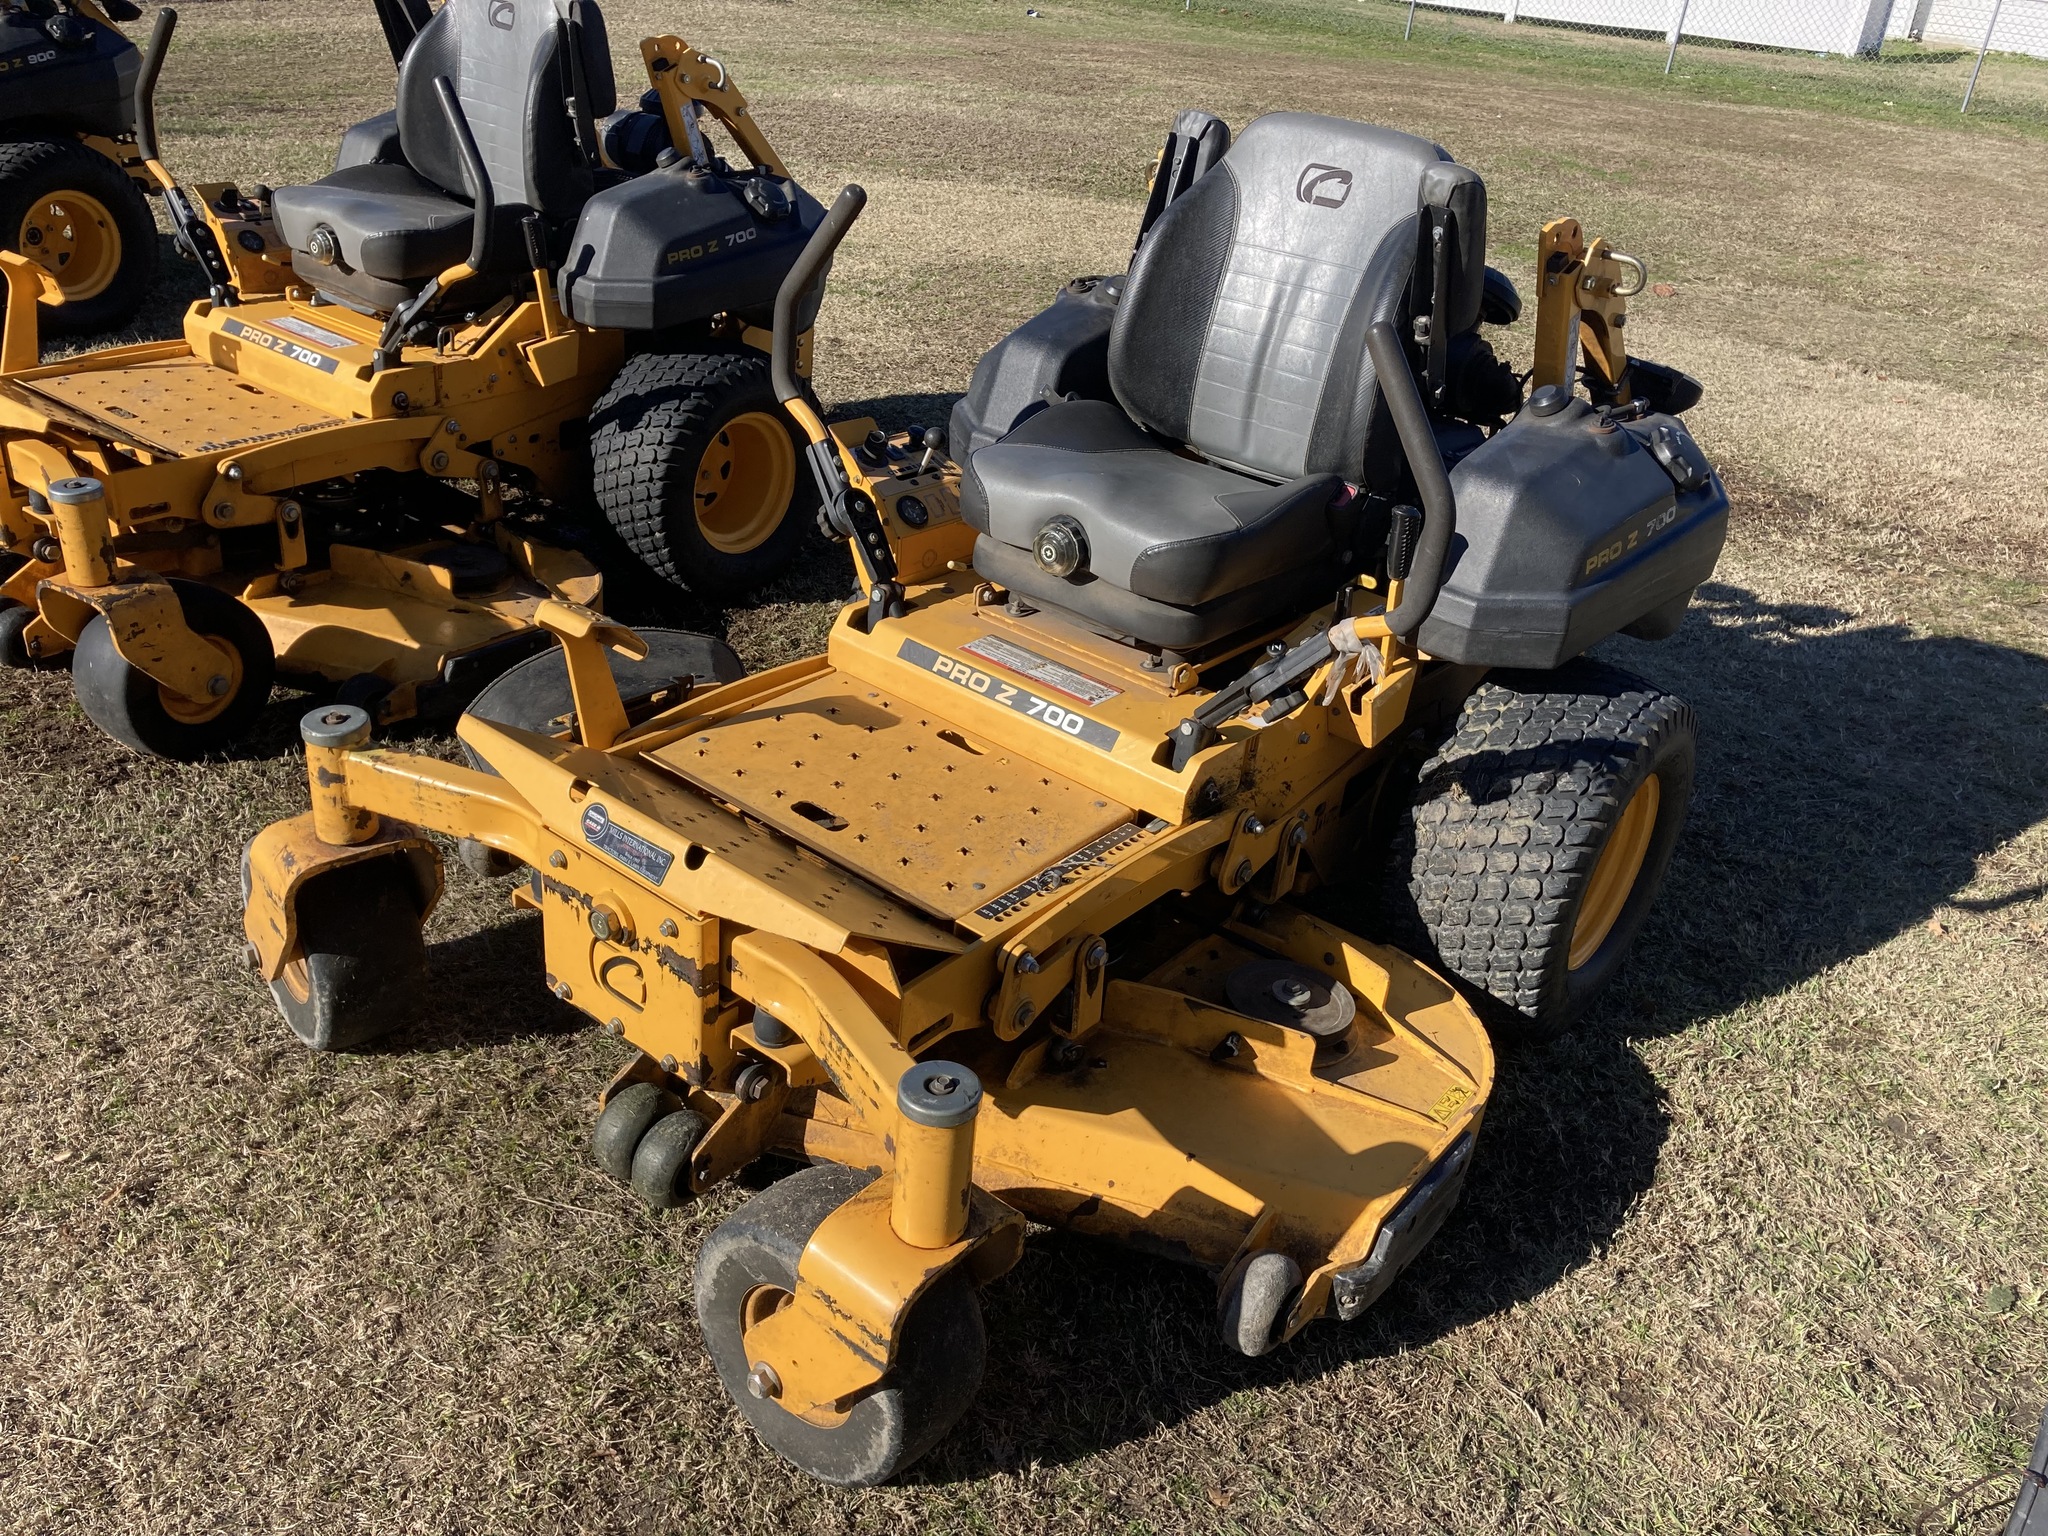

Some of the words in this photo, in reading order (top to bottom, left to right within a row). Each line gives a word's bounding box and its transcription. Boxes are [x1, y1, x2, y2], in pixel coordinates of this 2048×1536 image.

[12, 58, 24, 68] Z
[27, 50, 57, 65] 900
[667, 245, 703, 265] PRO
[707, 239, 719, 253] Z
[724, 227, 757, 247] 700
[240, 326, 273, 348] PRO
[273, 339, 287, 353] Z
[290, 346, 322, 367] 700
[1585, 541, 1623, 575] PRO
[1627, 530, 1639, 550] Z
[1646, 506, 1677, 537] 700
[931, 655, 991, 694] PRO
[994, 683, 1019, 706] Z
[1026, 696, 1085, 735] 700
[609, 826, 624, 840] MILLS
[622, 834, 657, 861] INTERNATIONAL
